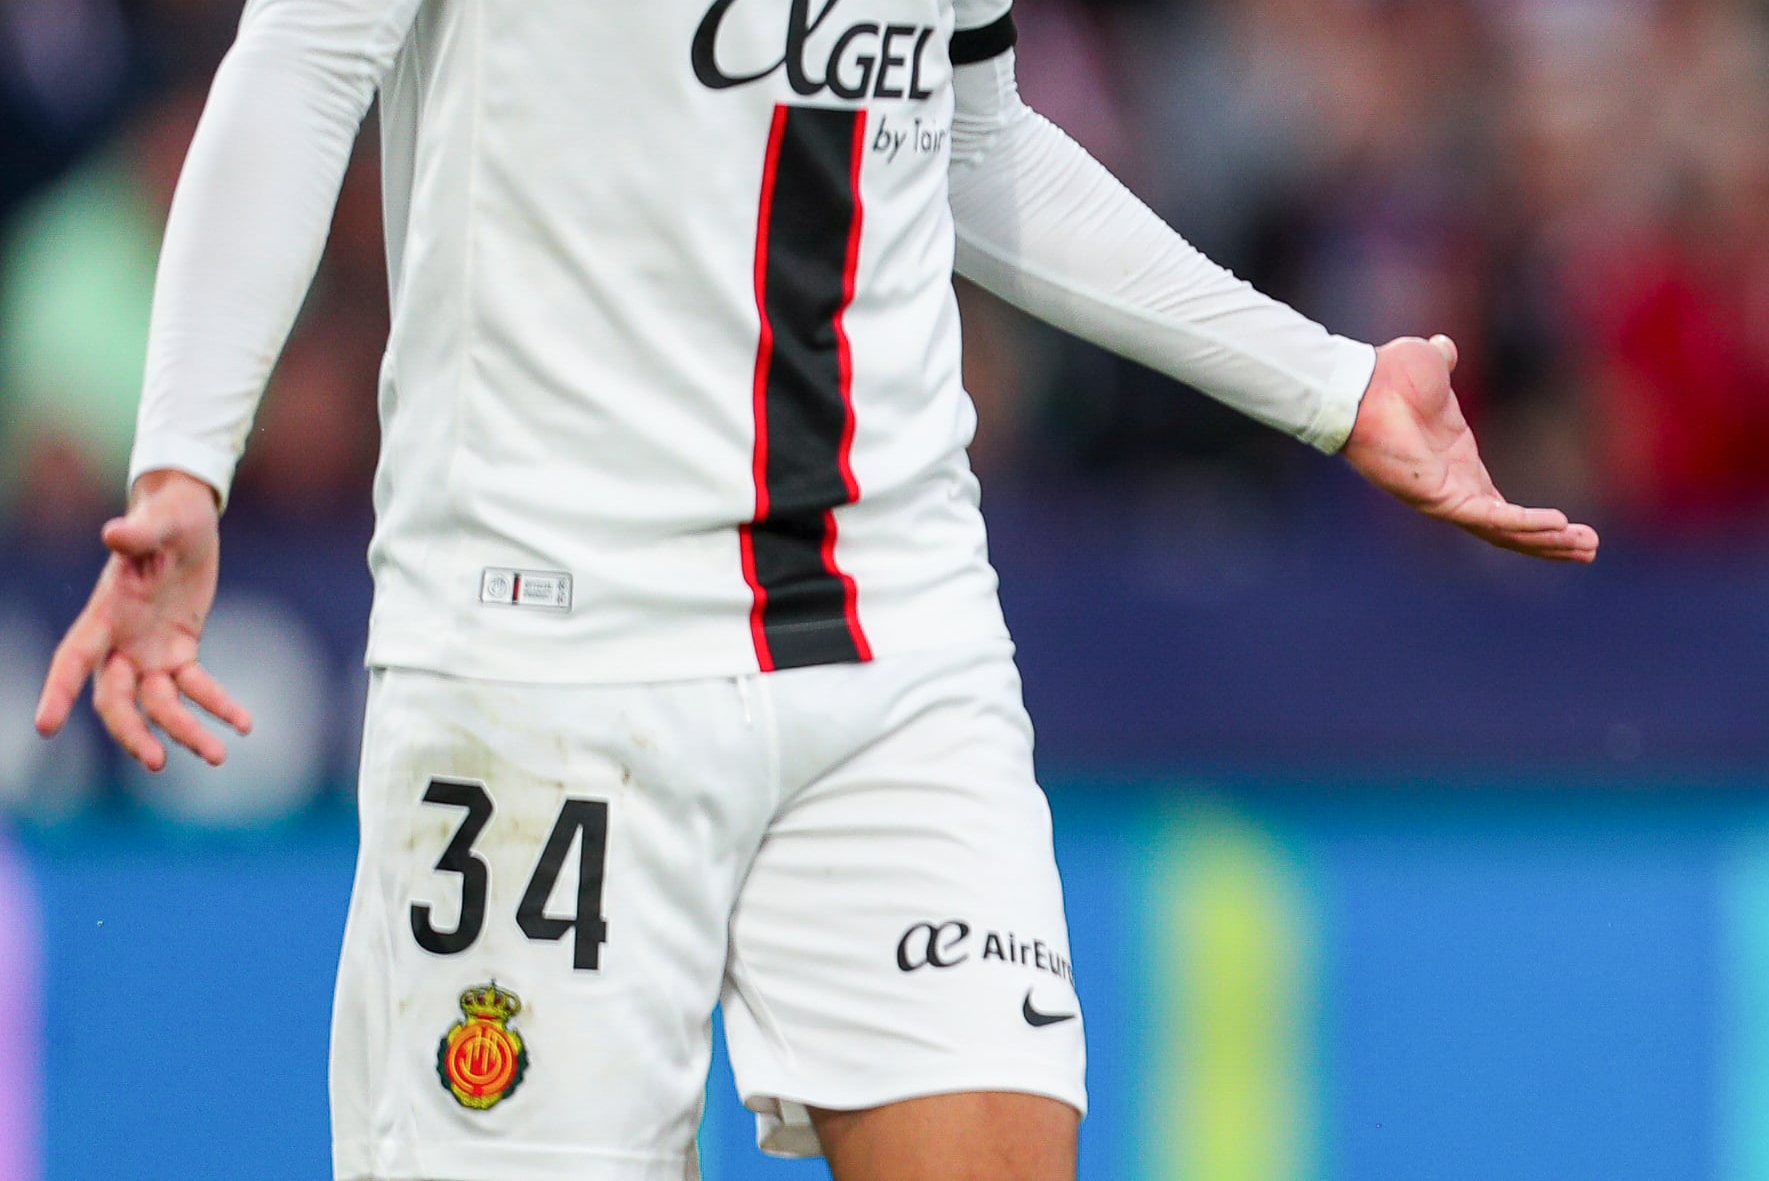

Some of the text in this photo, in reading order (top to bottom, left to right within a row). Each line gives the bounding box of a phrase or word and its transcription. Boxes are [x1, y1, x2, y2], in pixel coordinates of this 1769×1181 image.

[873, 114, 907, 165] by
[410, 779, 609, 970] 34
[983, 930, 1075, 988] AirEur
